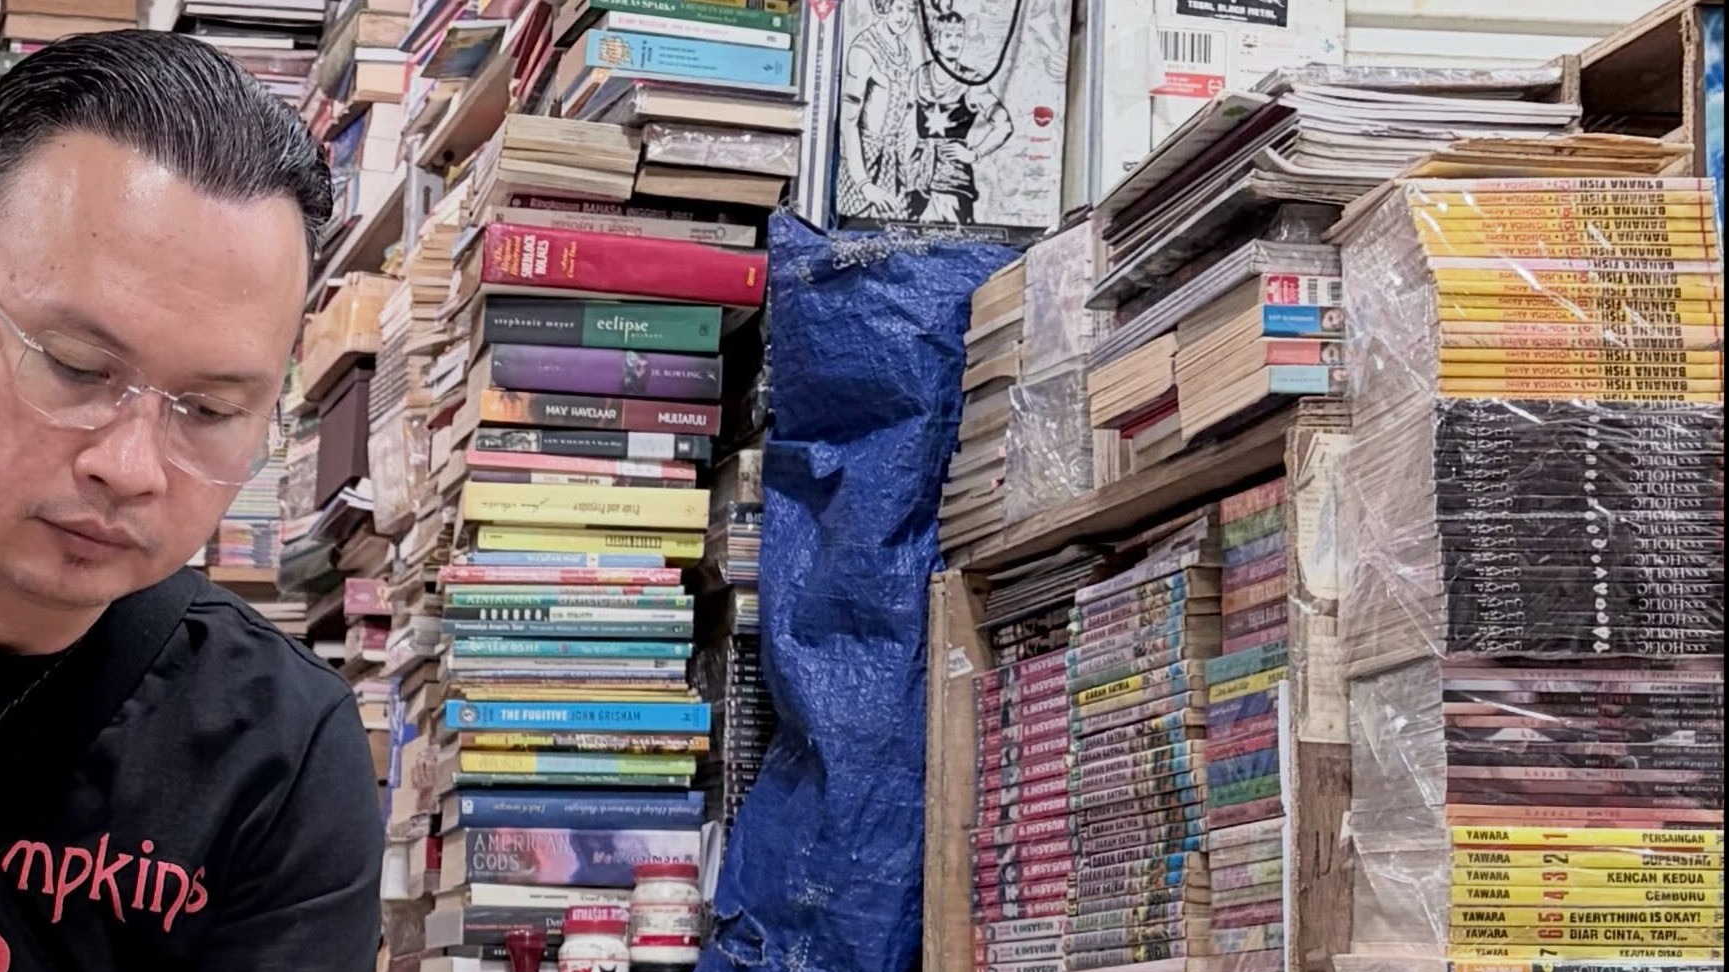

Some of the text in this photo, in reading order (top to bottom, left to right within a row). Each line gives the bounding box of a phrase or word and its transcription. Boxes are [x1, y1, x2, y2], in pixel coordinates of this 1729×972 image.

[1613, 206, 1666, 217] BANANA
[596, 316, 649, 343] eclipse
[1605, 351, 1631, 362] FISH
[1636, 351, 1687, 362] BANANA
[1604, 365, 1631, 377] FISH
[1635, 365, 1687, 377] BANANA
[1606, 380, 1631, 390] FISH
[1637, 380, 1687, 390] BANANA
[500, 709, 641, 721] THE FUGITIVE JOHN GRISHAM
[473, 833, 571, 851] AMERICAN
[1466, 830, 1705, 844] YAWARA 1 PERSAINGAN
[472, 854, 520, 871] GODS
[1466, 853, 1511, 865] YAWARA
[1543, 853, 1569, 865] 2
[1466, 871, 1705, 884] YAWARA 3 KENCAN KEDUA
[1466, 889, 1706, 901] YAWARA 4 CEMBURU
[1462, 911, 1701, 923] YAWARA 5 EVERYTHING IS OKAY!
[1464, 928, 1509, 941] YAWARA
[1537, 928, 1564, 941] 6
[1569, 928, 1598, 941] BIAR
[1604, 928, 1644, 941] CINTA,
[1539, 948, 1558, 958] 7
